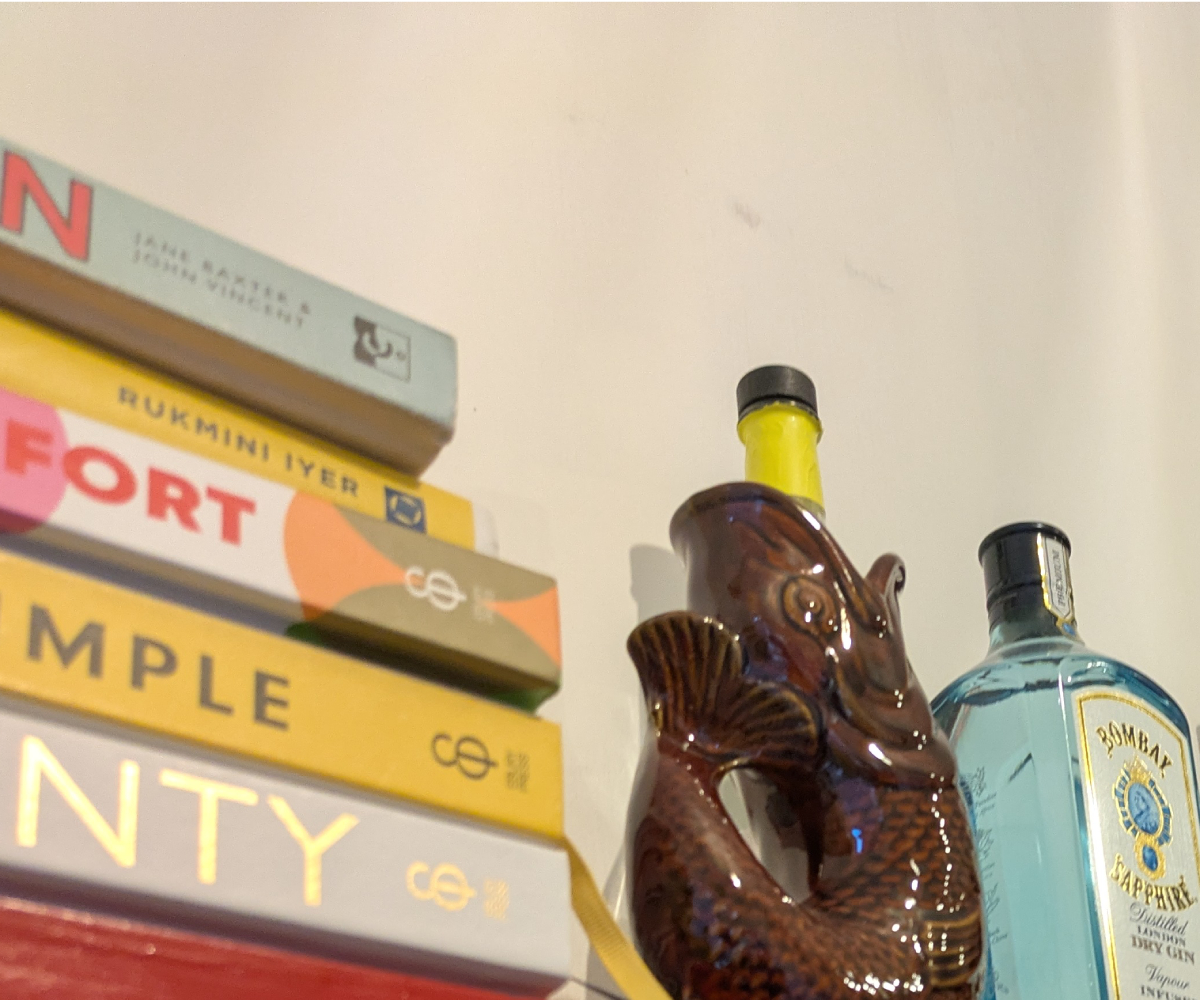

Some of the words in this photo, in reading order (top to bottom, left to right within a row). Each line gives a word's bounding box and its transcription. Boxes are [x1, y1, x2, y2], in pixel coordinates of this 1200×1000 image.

[132, 249, 196, 284] JOHN
[206, 278, 304, 328] VINCENT
[133, 232, 189, 263] JANE
[201, 259, 287, 302] BAXTER
[117, 386, 270, 462] RUKMINI
[285, 446, 360, 498] IYER
[4, 418, 258, 547] FORT
[1096, 721, 1173, 779] BOMBAY
[15, 734, 361, 908] NTY
[1110, 853, 1196, 912] SAPPHIRE
[1129, 902, 1189, 936] Distilled
[1137, 925, 1187, 948] LONDON
[1131, 934, 1163, 956] DRY
[1166, 944, 1195, 966] GIN
[1145, 963, 1190, 990] Vapour
